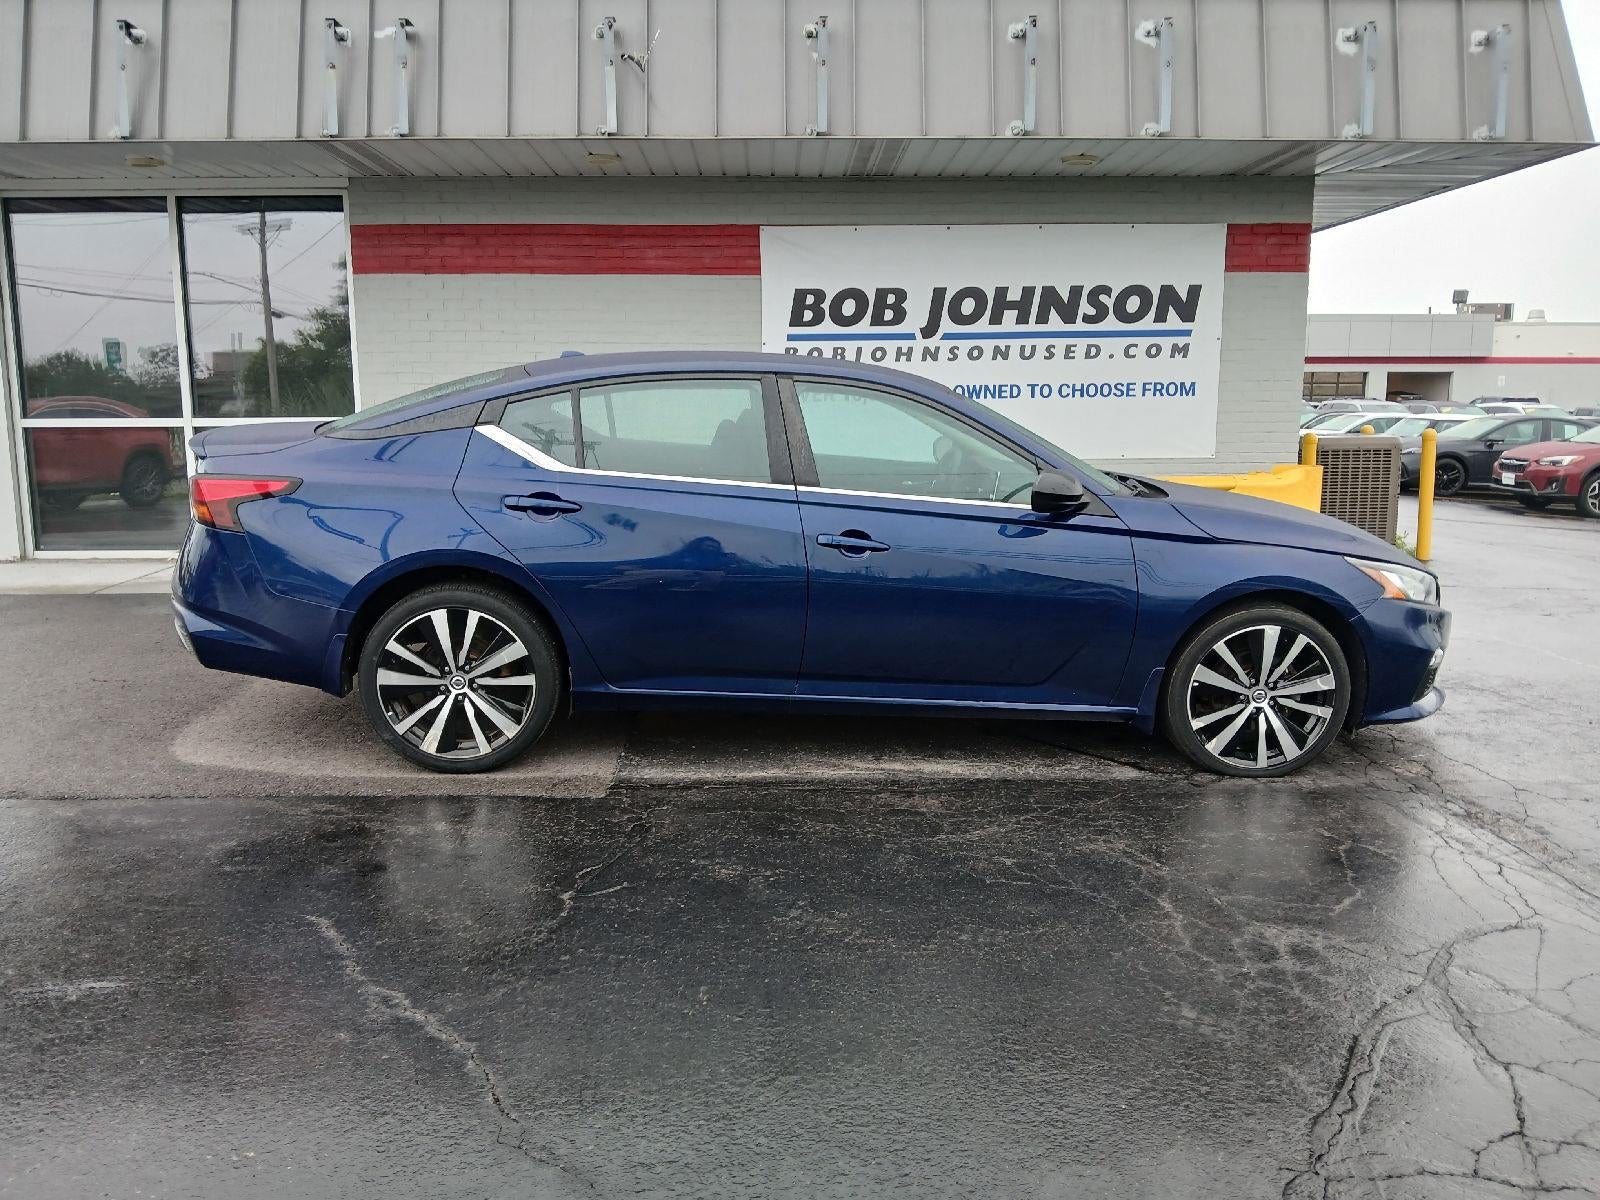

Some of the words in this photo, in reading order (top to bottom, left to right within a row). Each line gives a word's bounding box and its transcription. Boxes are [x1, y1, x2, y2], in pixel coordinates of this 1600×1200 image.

[789, 287, 908, 328] BOB
[919, 284, 1202, 340] JOHNSON
[1027, 383, 1053, 399] TO
[1057, 382, 1137, 399] CHOOSE
[1141, 381, 1197, 398] FROM
